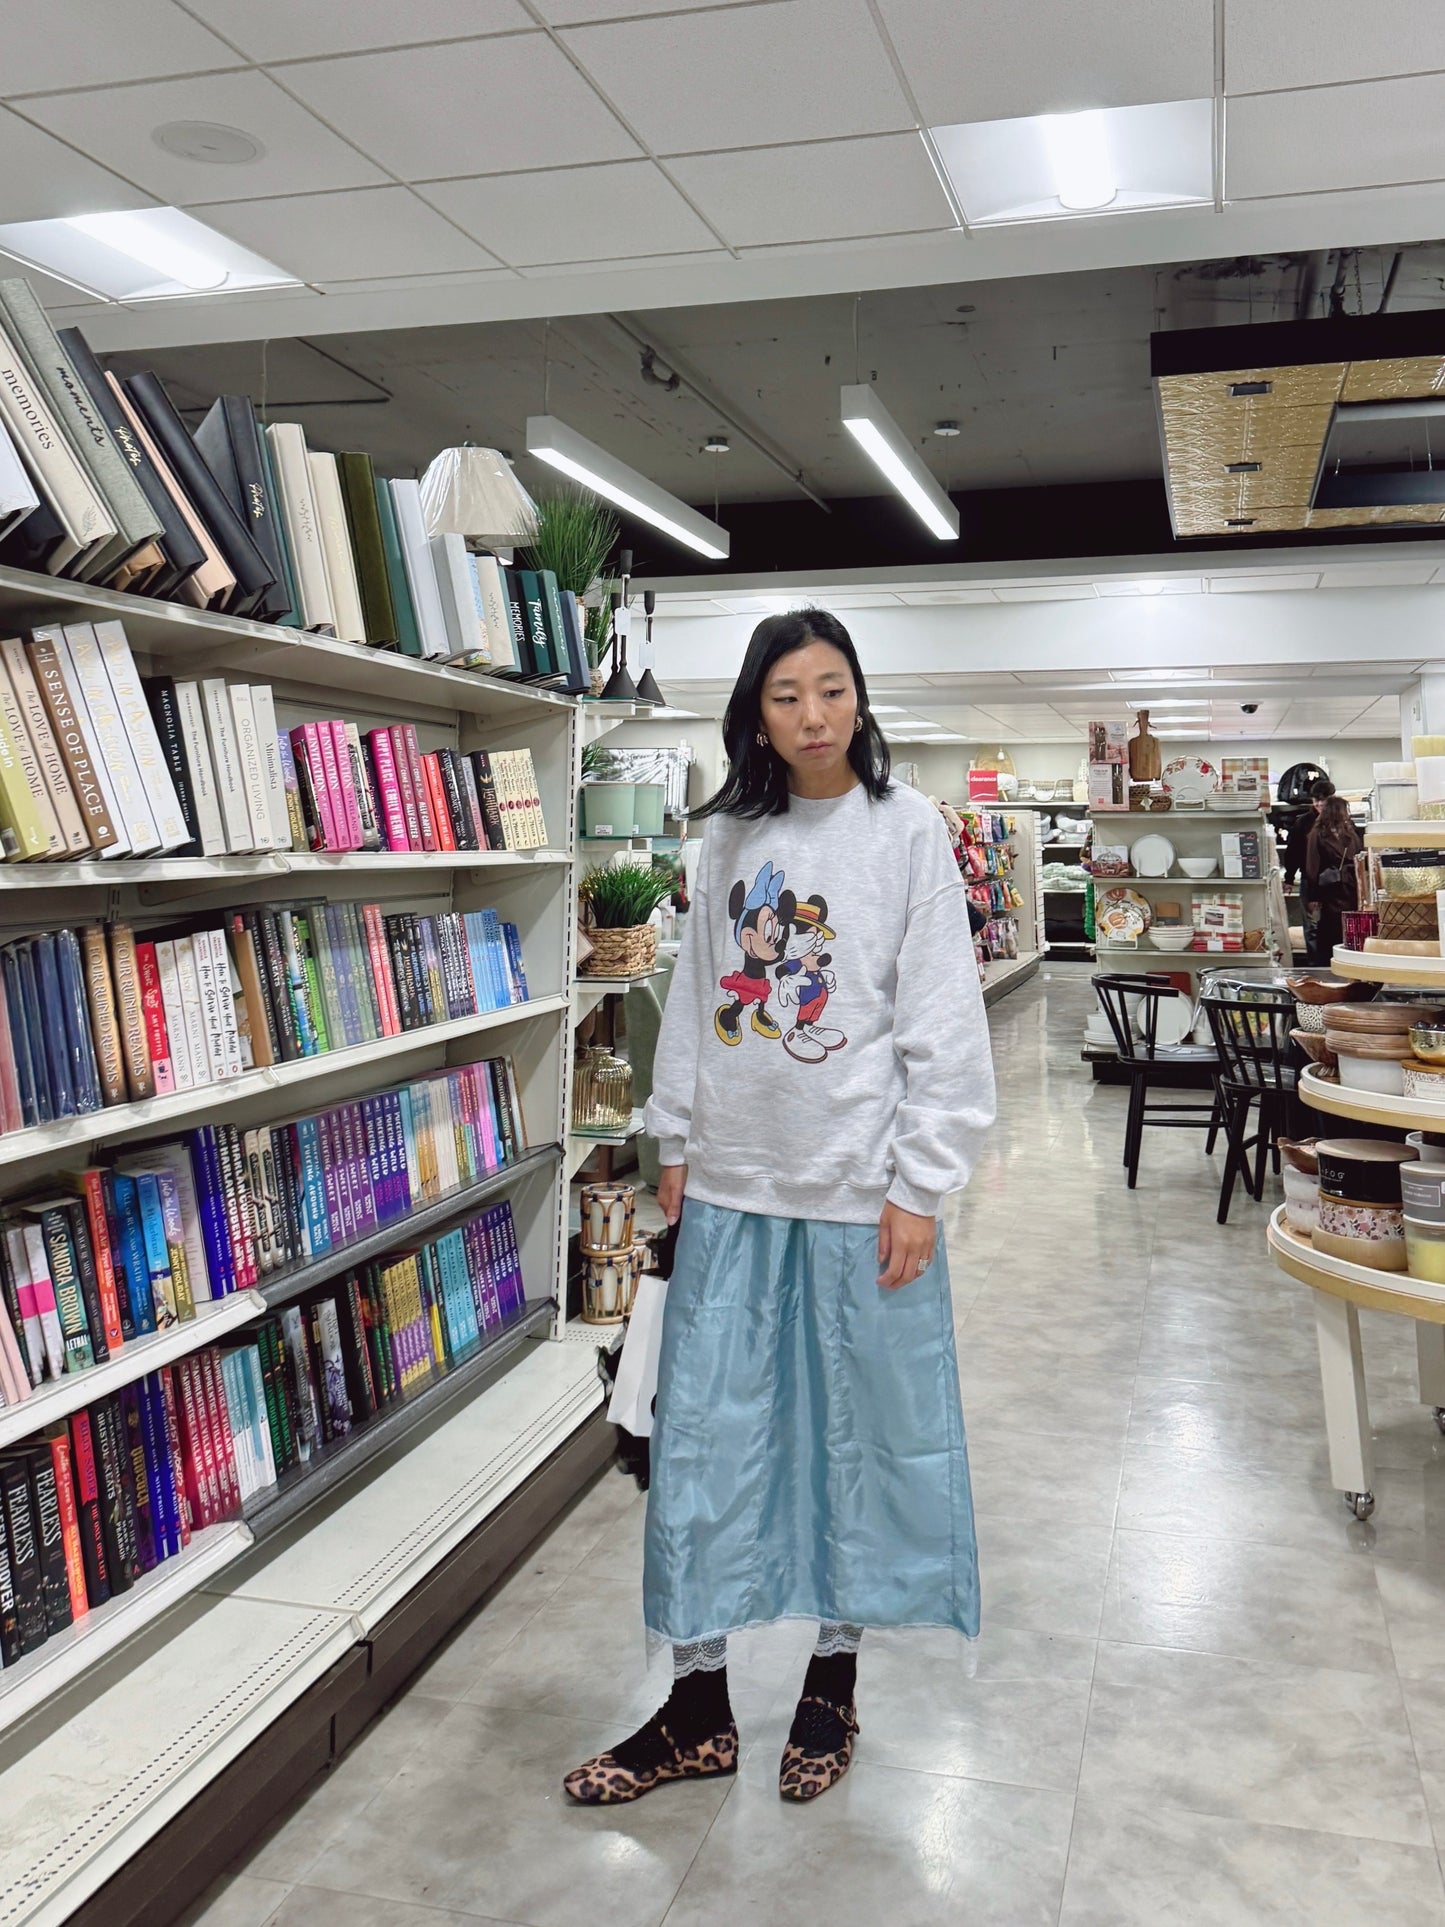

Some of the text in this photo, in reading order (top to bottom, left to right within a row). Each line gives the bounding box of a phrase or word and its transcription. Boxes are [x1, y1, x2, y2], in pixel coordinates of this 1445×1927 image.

[1, 366, 55, 451] memories
[55, 363, 109, 448] moments
[506, 600, 527, 642] MEMORIES
[4, 706, 24, 743] LOVE
[28, 703, 49, 740] LOVE
[43, 667, 103, 816] SENSE OF PLACE
[157, 689, 178, 739] MAGNOLIA
[169, 743, 183, 772] TABLE
[17, 744, 27, 753] of
[42, 741, 53, 750] of
[220, 738, 230, 763] Furniture
[225, 763, 235, 792] Handbook
[264, 742, 279, 790] Minimalista
[305, 736, 328, 792] INVITATION
[320, 735, 340, 789] INVITATION
[333, 734, 355, 788] INVITATION
[374, 732, 390, 757] HAPPY
[20, 754, 42, 799] HOME
[44, 751, 68, 795] HOME
[192, 741, 202, 767] Furniture
[197, 767, 207, 796] Handbook
[240, 718, 266, 820] ORGANIZED LIVING
[379, 758, 394, 782] PLACE
[285, 792, 299, 837] JENNY HOLIDAY
[385, 788, 400, 812] EMILY
[405, 802, 414, 816] ALLY
[481, 786, 503, 826] LIGHTLARK
[389, 814, 404, 839] HENRY
[408, 816, 418, 838] CARTER
[251, 926, 264, 967] SKELETON
[258, 969, 266, 984] KEY
[365, 909, 376, 944] ARCHER'S
[371, 946, 379, 967] VOICE
[373, 908, 385, 943] ARCHER'S
[379, 944, 389, 965] VOICE
[142, 962, 156, 986] Sweet
[270, 959, 281, 986] KEATS
[408, 952, 422, 991] GRANDEST
[416, 950, 431, 989] GRANDEST
[88, 945, 118, 1082] FOUR RUINED REALMS
[115, 940, 146, 1076] FOUR RUINED REALMS
[144, 988, 159, 1009] Spot
[151, 1013, 160, 1027] AMY
[170, 1014, 187, 1071] MARNI MANN
[188, 1010, 204, 1068] MARNI MANN
[496, 1076, 511, 1136] SANDRA BROWN
[91, 1177, 99, 1190] the
[204, 1165, 213, 1193] MYSTERY
[338, 1168, 347, 1196] SWEET
[370, 1157, 379, 1180] WILD
[380, 1153, 388, 1175] WILD
[92, 1190, 101, 1208] Look
[159, 1177, 181, 1236] Into the Woods
[208, 1196, 217, 1218] GUEST
[218, 1146, 242, 1241] HARLAN COBEN
[229, 1143, 253, 1237] HARLAN COBEN
[308, 1184, 319, 1219] AROUND
[325, 1173, 335, 1201] SWEET
[213, 1162, 223, 1191] MYSTERY
[218, 1193, 226, 1215] GUEST
[224, 1236, 233, 1257] PROSE
[98, 1235, 106, 1246] Air
[124, 1216, 135, 1236] RUIN
[130, 1251, 142, 1281] WRATH
[145, 1208, 163, 1257] Hilderbrand
[215, 1239, 223, 1260] PROSE
[48, 1233, 85, 1333] SANDRA BROWN
[169, 1247, 185, 1300] JENNY HOLIDAY
[66, 1334, 90, 1351] LETHAL
[191, 1369, 214, 1466] APPRENTICE VILLAIN
[265, 1384, 278, 1424] LINWOOD
[275, 1376, 288, 1417] LINWOOD
[168, 1415, 179, 1447] LAST
[180, 1374, 204, 1472] APPRENTICE VILLAIN
[271, 1425, 284, 1462] BARCLAY
[281, 1418, 293, 1455] BARCLAY
[77, 1421, 95, 1494] RILEY SAGER
[95, 1412, 116, 1499] BRISTOL KEATS
[172, 1449, 184, 1486] WORDS
[8, 1485, 34, 1564] FEARLESS
[38, 1469, 62, 1546] FEARLESS
[63, 1482, 71, 1502] Love
[70, 1540, 83, 1594] HAZELWOOD
[89, 1503, 107, 1580] THE ONLY ONE LEFT
[114, 1523, 125, 1559] PEARSON
[0, 1549, 14, 1613] HOOVER
